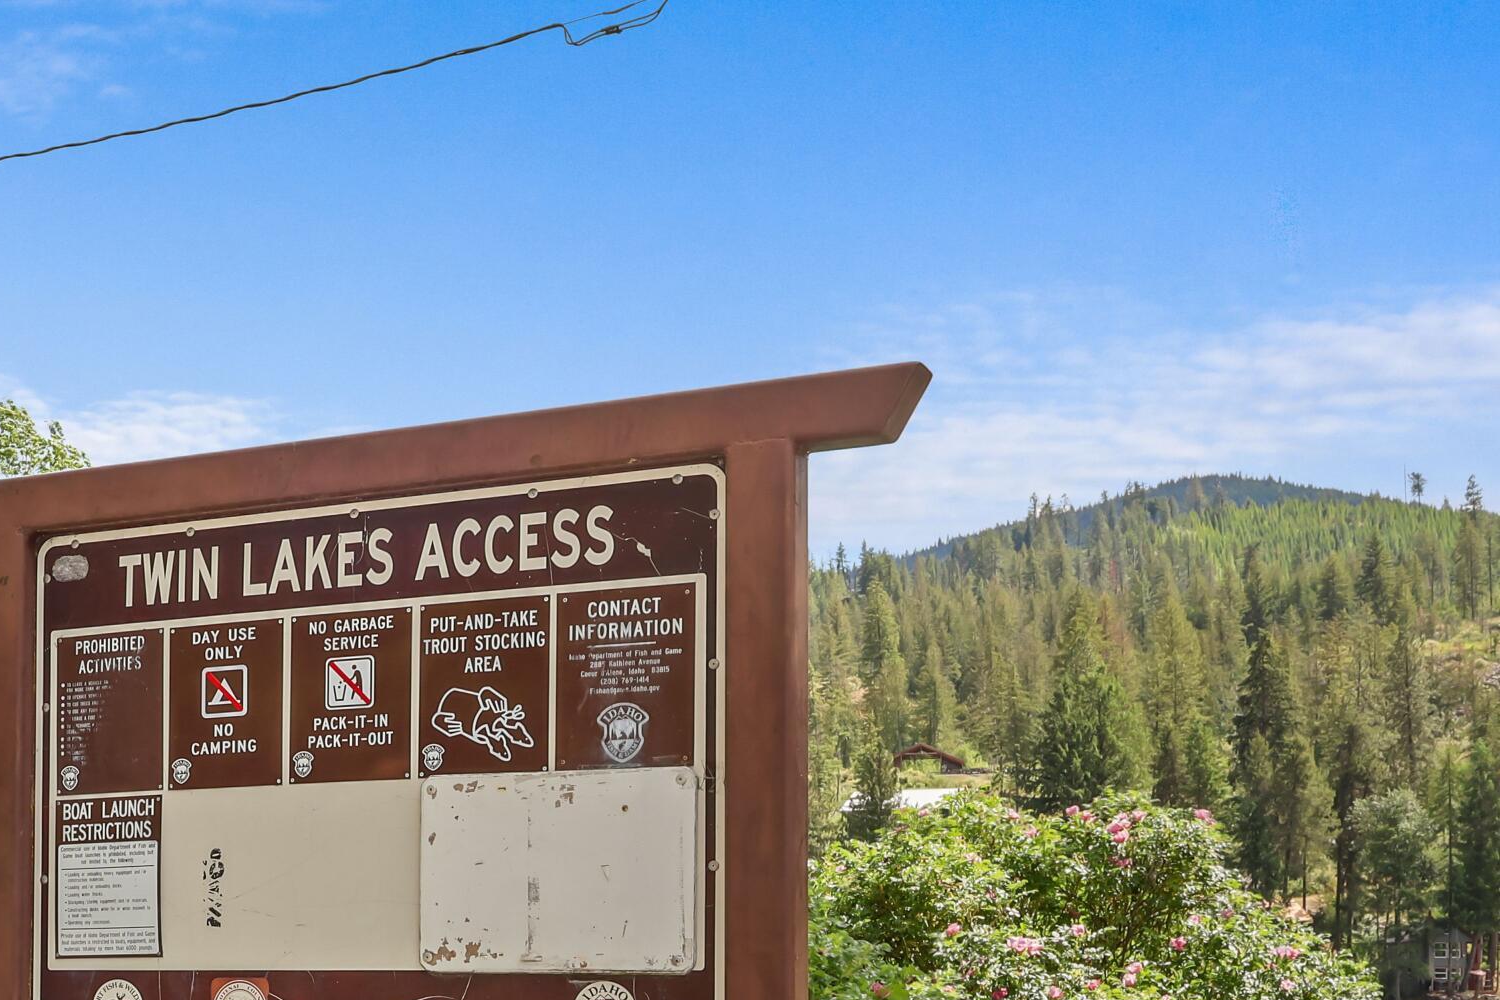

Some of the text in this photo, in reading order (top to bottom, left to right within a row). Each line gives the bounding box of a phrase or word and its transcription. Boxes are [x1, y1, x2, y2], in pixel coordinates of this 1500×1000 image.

[118, 505, 616, 607] TWIN LAKES ACCESS
[588, 597, 661, 618] CONTACT
[309, 616, 394, 635] NO GARBAGE
[430, 610, 538, 633] PUT-AND-TAKE
[569, 618, 682, 641] INFORMATION
[192, 627, 256, 645] DAY USE
[324, 634, 378, 651] SERVICE
[423, 631, 546, 655] TROUT STOCKING
[76, 636, 144, 656] PROHIBITED
[204, 645, 243, 660] ONLY
[78, 656, 142, 674] ACTIVITIES
[464, 656, 502, 673] AREA
[314, 714, 388, 731] PACK-IT-IN
[603, 706, 643, 723] IDAHO
[214, 724, 233, 737] NO
[191, 739, 257, 756] CAMPING
[308, 731, 393, 749] PACK-IT-OUT
[63, 799, 155, 820] BOAT LAUNCH
[63, 821, 152, 842] RESTRICTIONS
[103, 982, 118, 992] FISH
